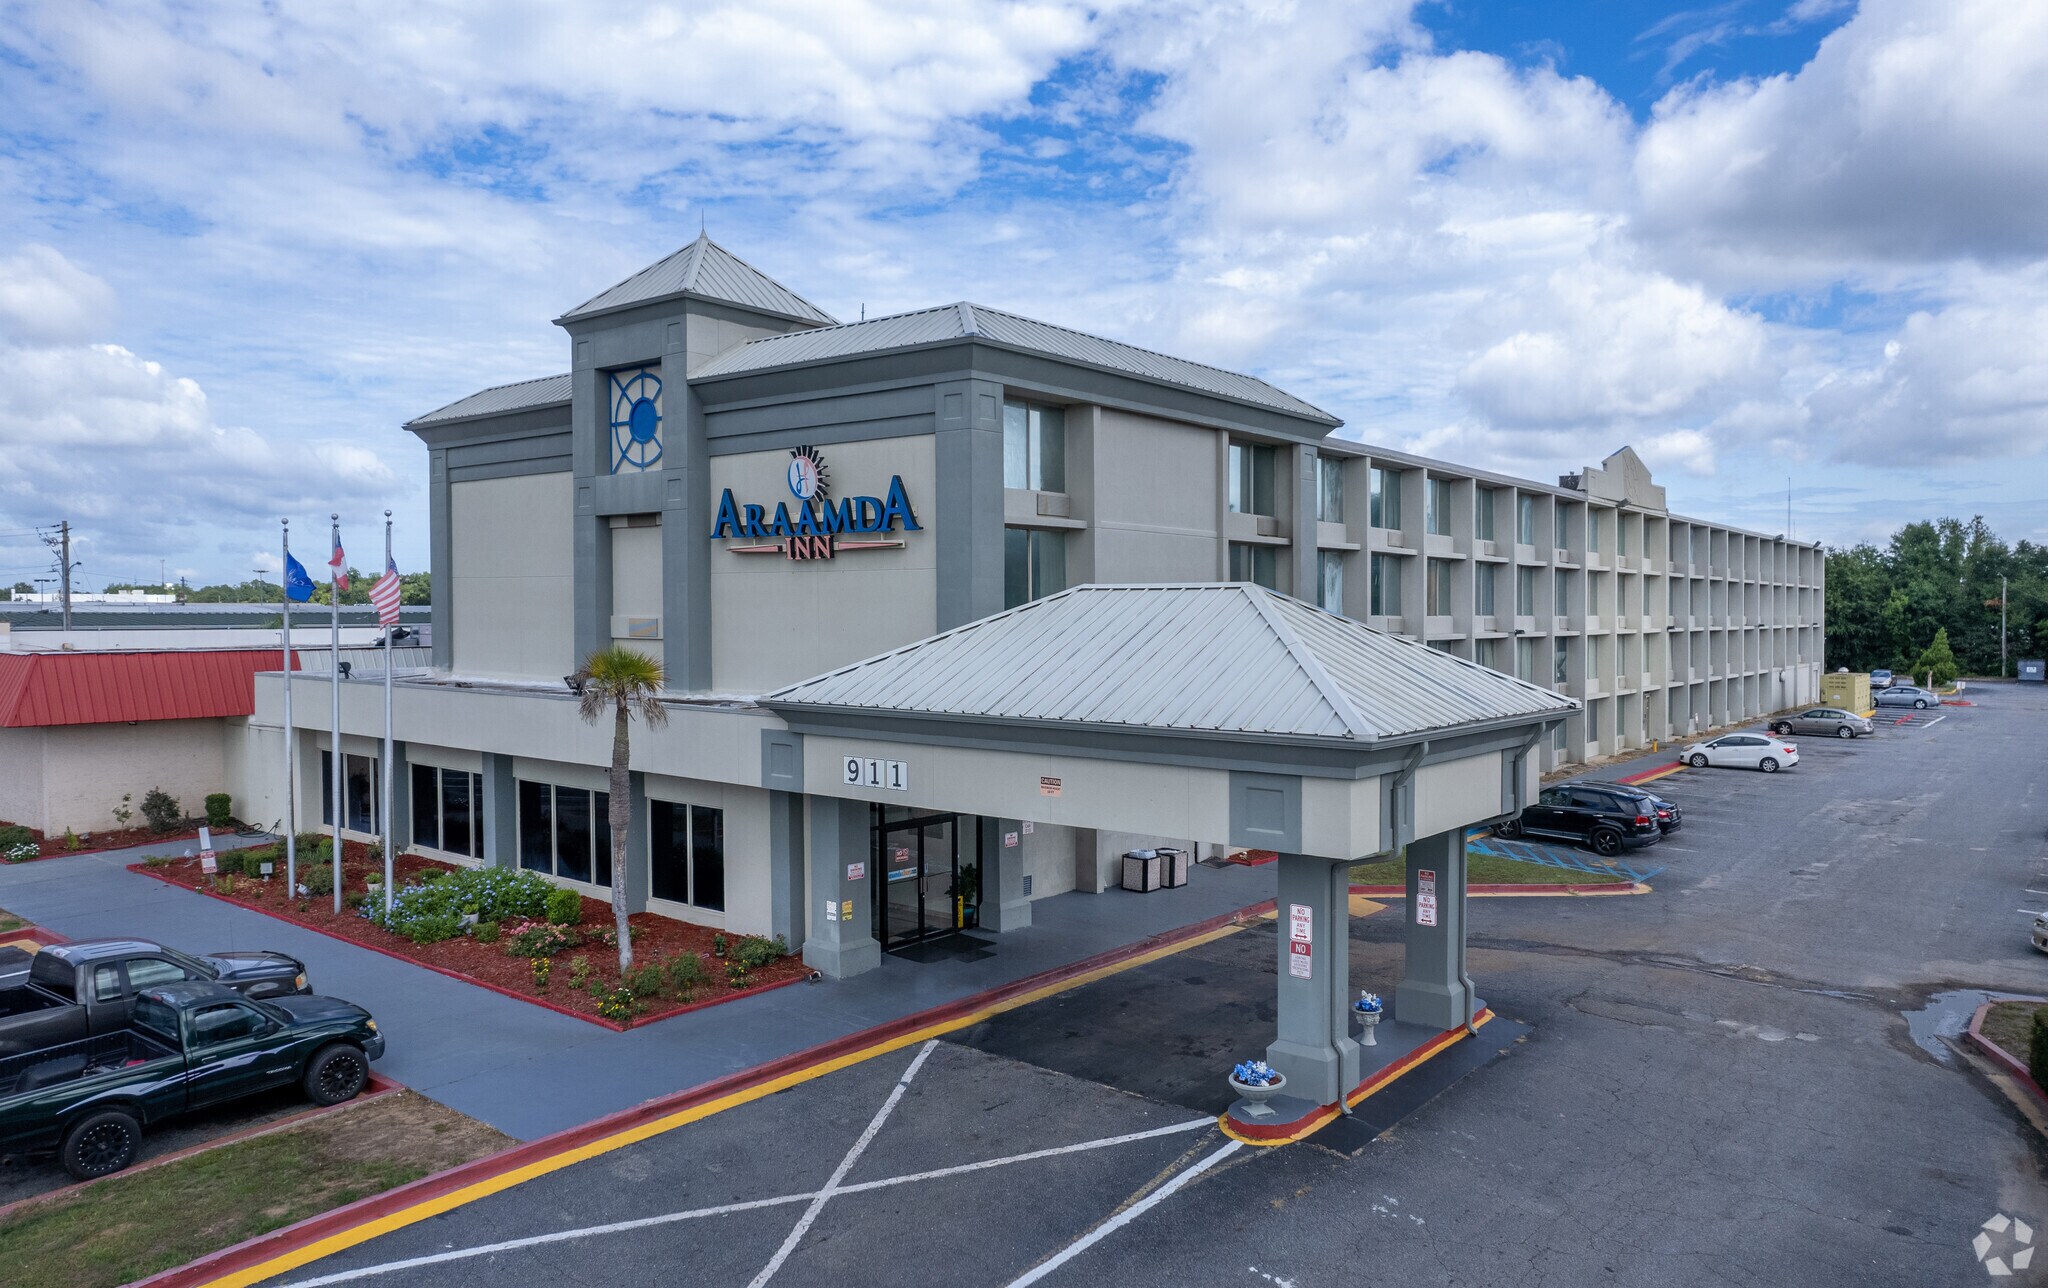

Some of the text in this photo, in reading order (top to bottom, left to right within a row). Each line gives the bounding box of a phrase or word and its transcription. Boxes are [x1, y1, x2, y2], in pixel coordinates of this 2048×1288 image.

[710, 474, 924, 540] ARAAMDA
[785, 534, 835, 560] INN
[846, 757, 903, 789] 911
[1041, 777, 1061, 785] CAUTION
[1422, 896, 1431, 904] NO
[1418, 902, 1435, 910] PARKING
[1296, 907, 1306, 916] NO
[1292, 914, 1310, 924] PARKING
[1295, 943, 1307, 954] NO
